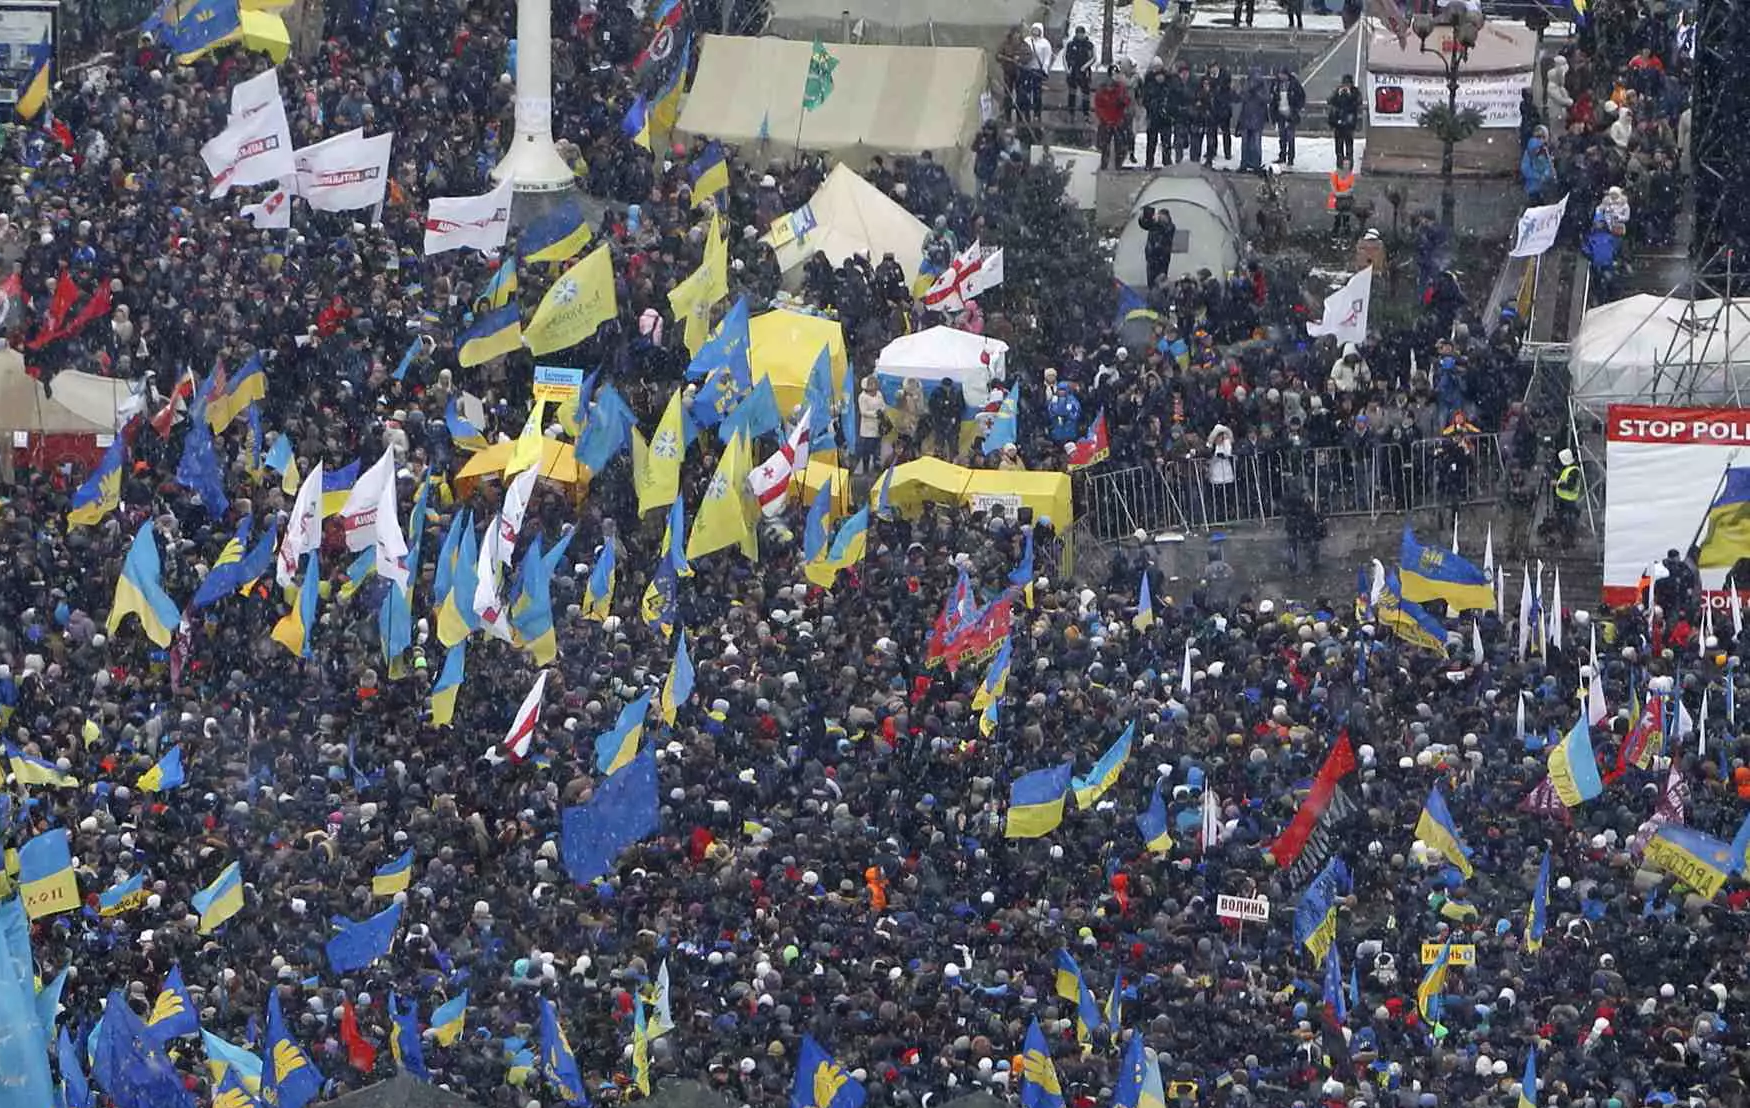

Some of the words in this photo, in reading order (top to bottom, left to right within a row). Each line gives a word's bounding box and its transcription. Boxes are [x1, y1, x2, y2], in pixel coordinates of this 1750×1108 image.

[1618, 419, 1684, 438] STOP
[1221, 898, 1266, 916] ВОЛИНЬ
[1424, 948, 1462, 961] УМНЬ
